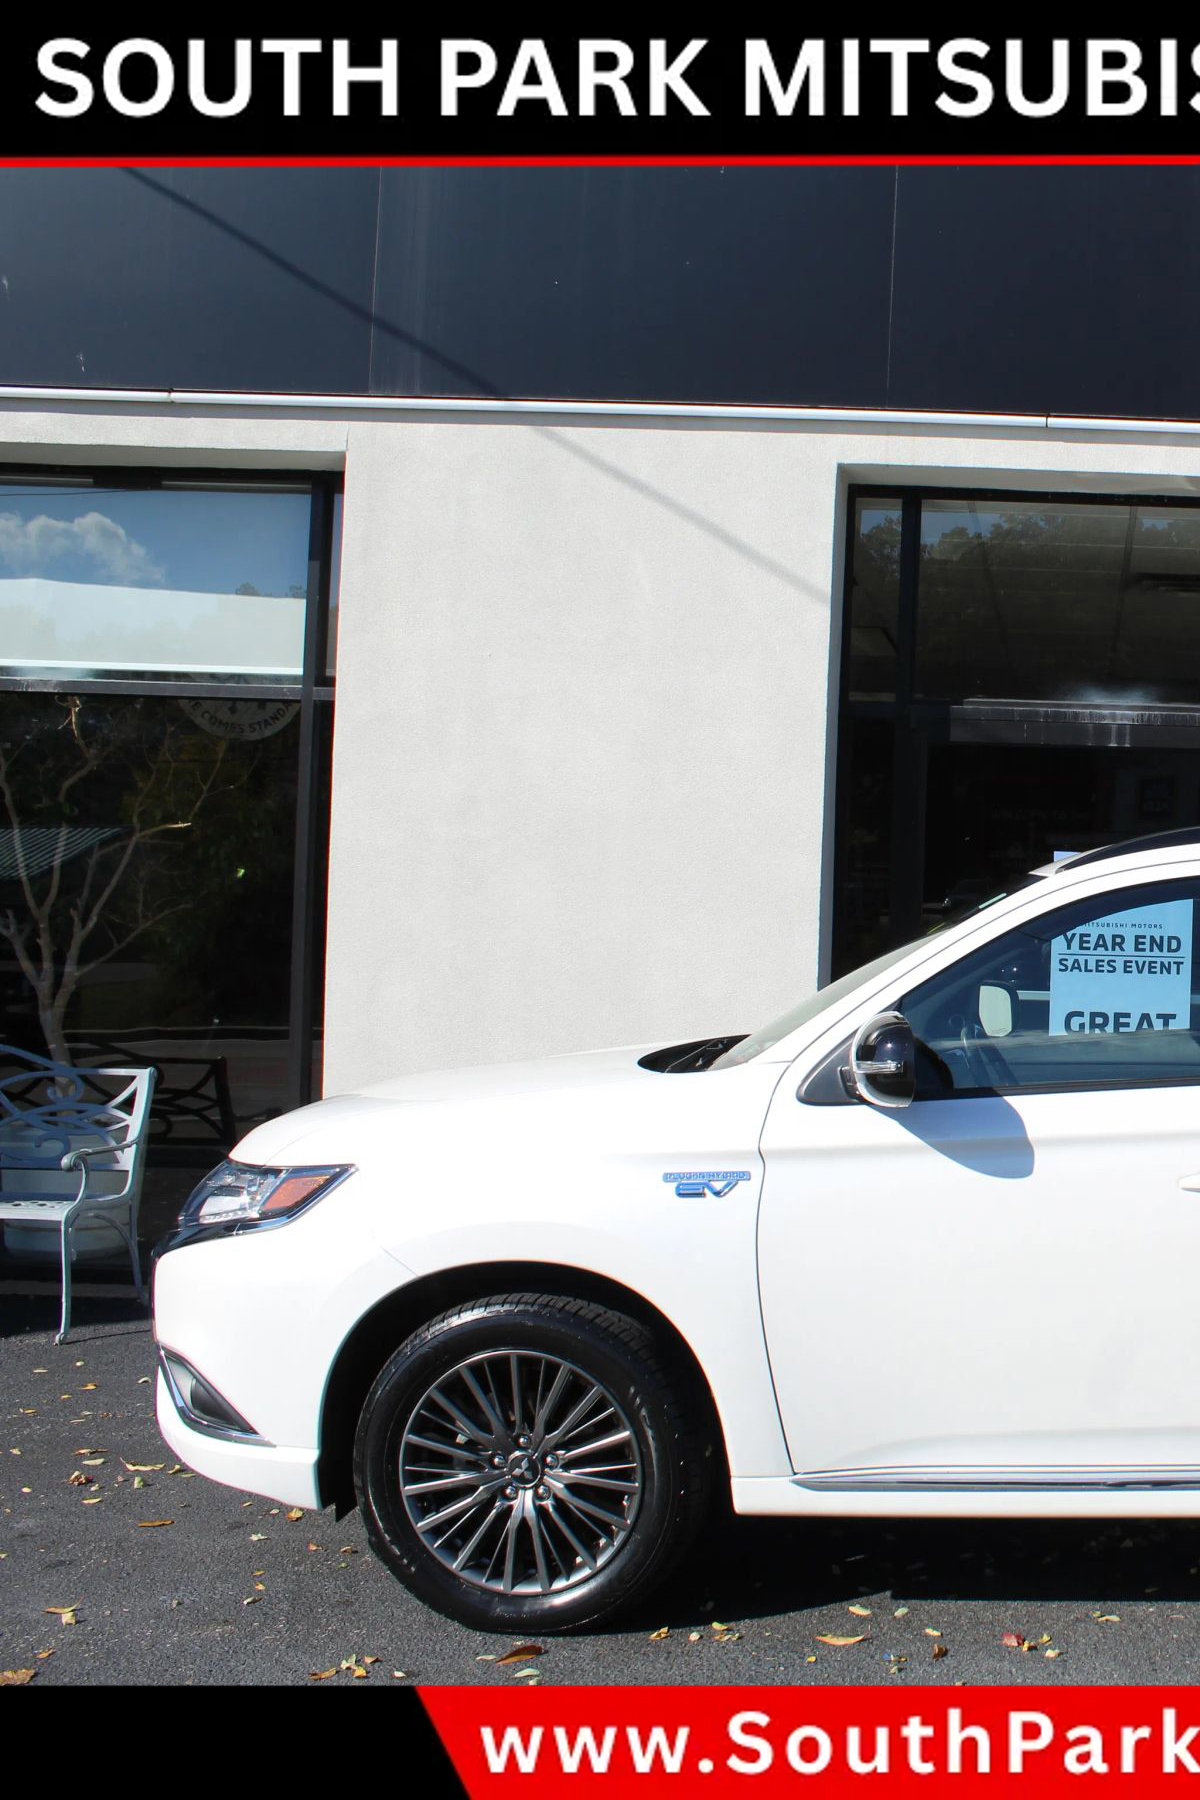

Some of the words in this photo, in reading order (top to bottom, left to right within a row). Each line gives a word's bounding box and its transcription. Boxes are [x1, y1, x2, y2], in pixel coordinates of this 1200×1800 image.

[1062, 932, 1126, 952] YEAR
[1133, 934, 1182, 953] END
[1058, 958, 1117, 974] SALES
[1123, 960, 1184, 975] EVENT
[1064, 1010, 1177, 1035] GREAT
[675, 1180, 739, 1198] EV
